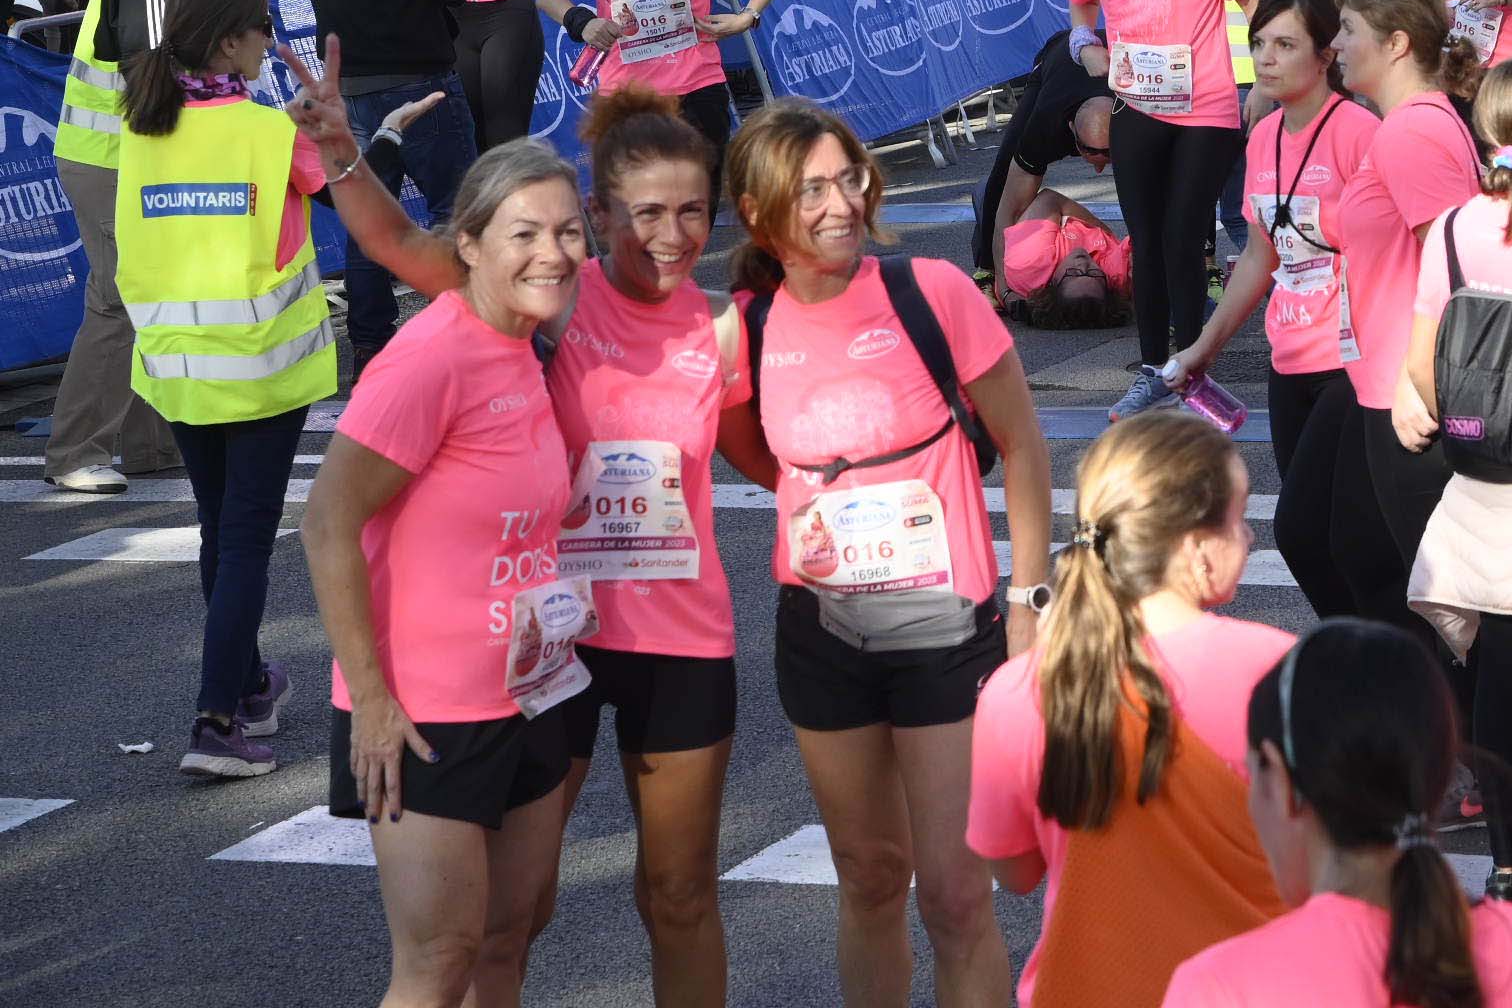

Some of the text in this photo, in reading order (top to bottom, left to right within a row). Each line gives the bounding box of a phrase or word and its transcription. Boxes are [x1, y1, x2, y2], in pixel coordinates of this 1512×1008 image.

[640, 14, 667, 28] 016
[1456, 21, 1476, 36] 016
[646, 27, 666, 36] 15017
[1136, 74, 1164, 84] 016
[1139, 86, 1160, 94] 15944
[143, 191, 246, 210] VOLUNTARIS
[565, 328, 625, 359] OYSHO
[595, 495, 648, 515] 016
[500, 508, 540, 540] TU
[836, 510, 893, 527] ASTURIANA
[601, 521, 641, 534] 16967
[561, 539, 601, 551] CARRERA
[602, 539, 616, 549] DE
[617, 539, 630, 548] LA
[631, 538, 663, 549] MUJER
[843, 540, 894, 565] 016
[557, 557, 689, 572] OYSHO Santander
[850, 566, 892, 582] 16968
[886, 579, 914, 590] MUJER
